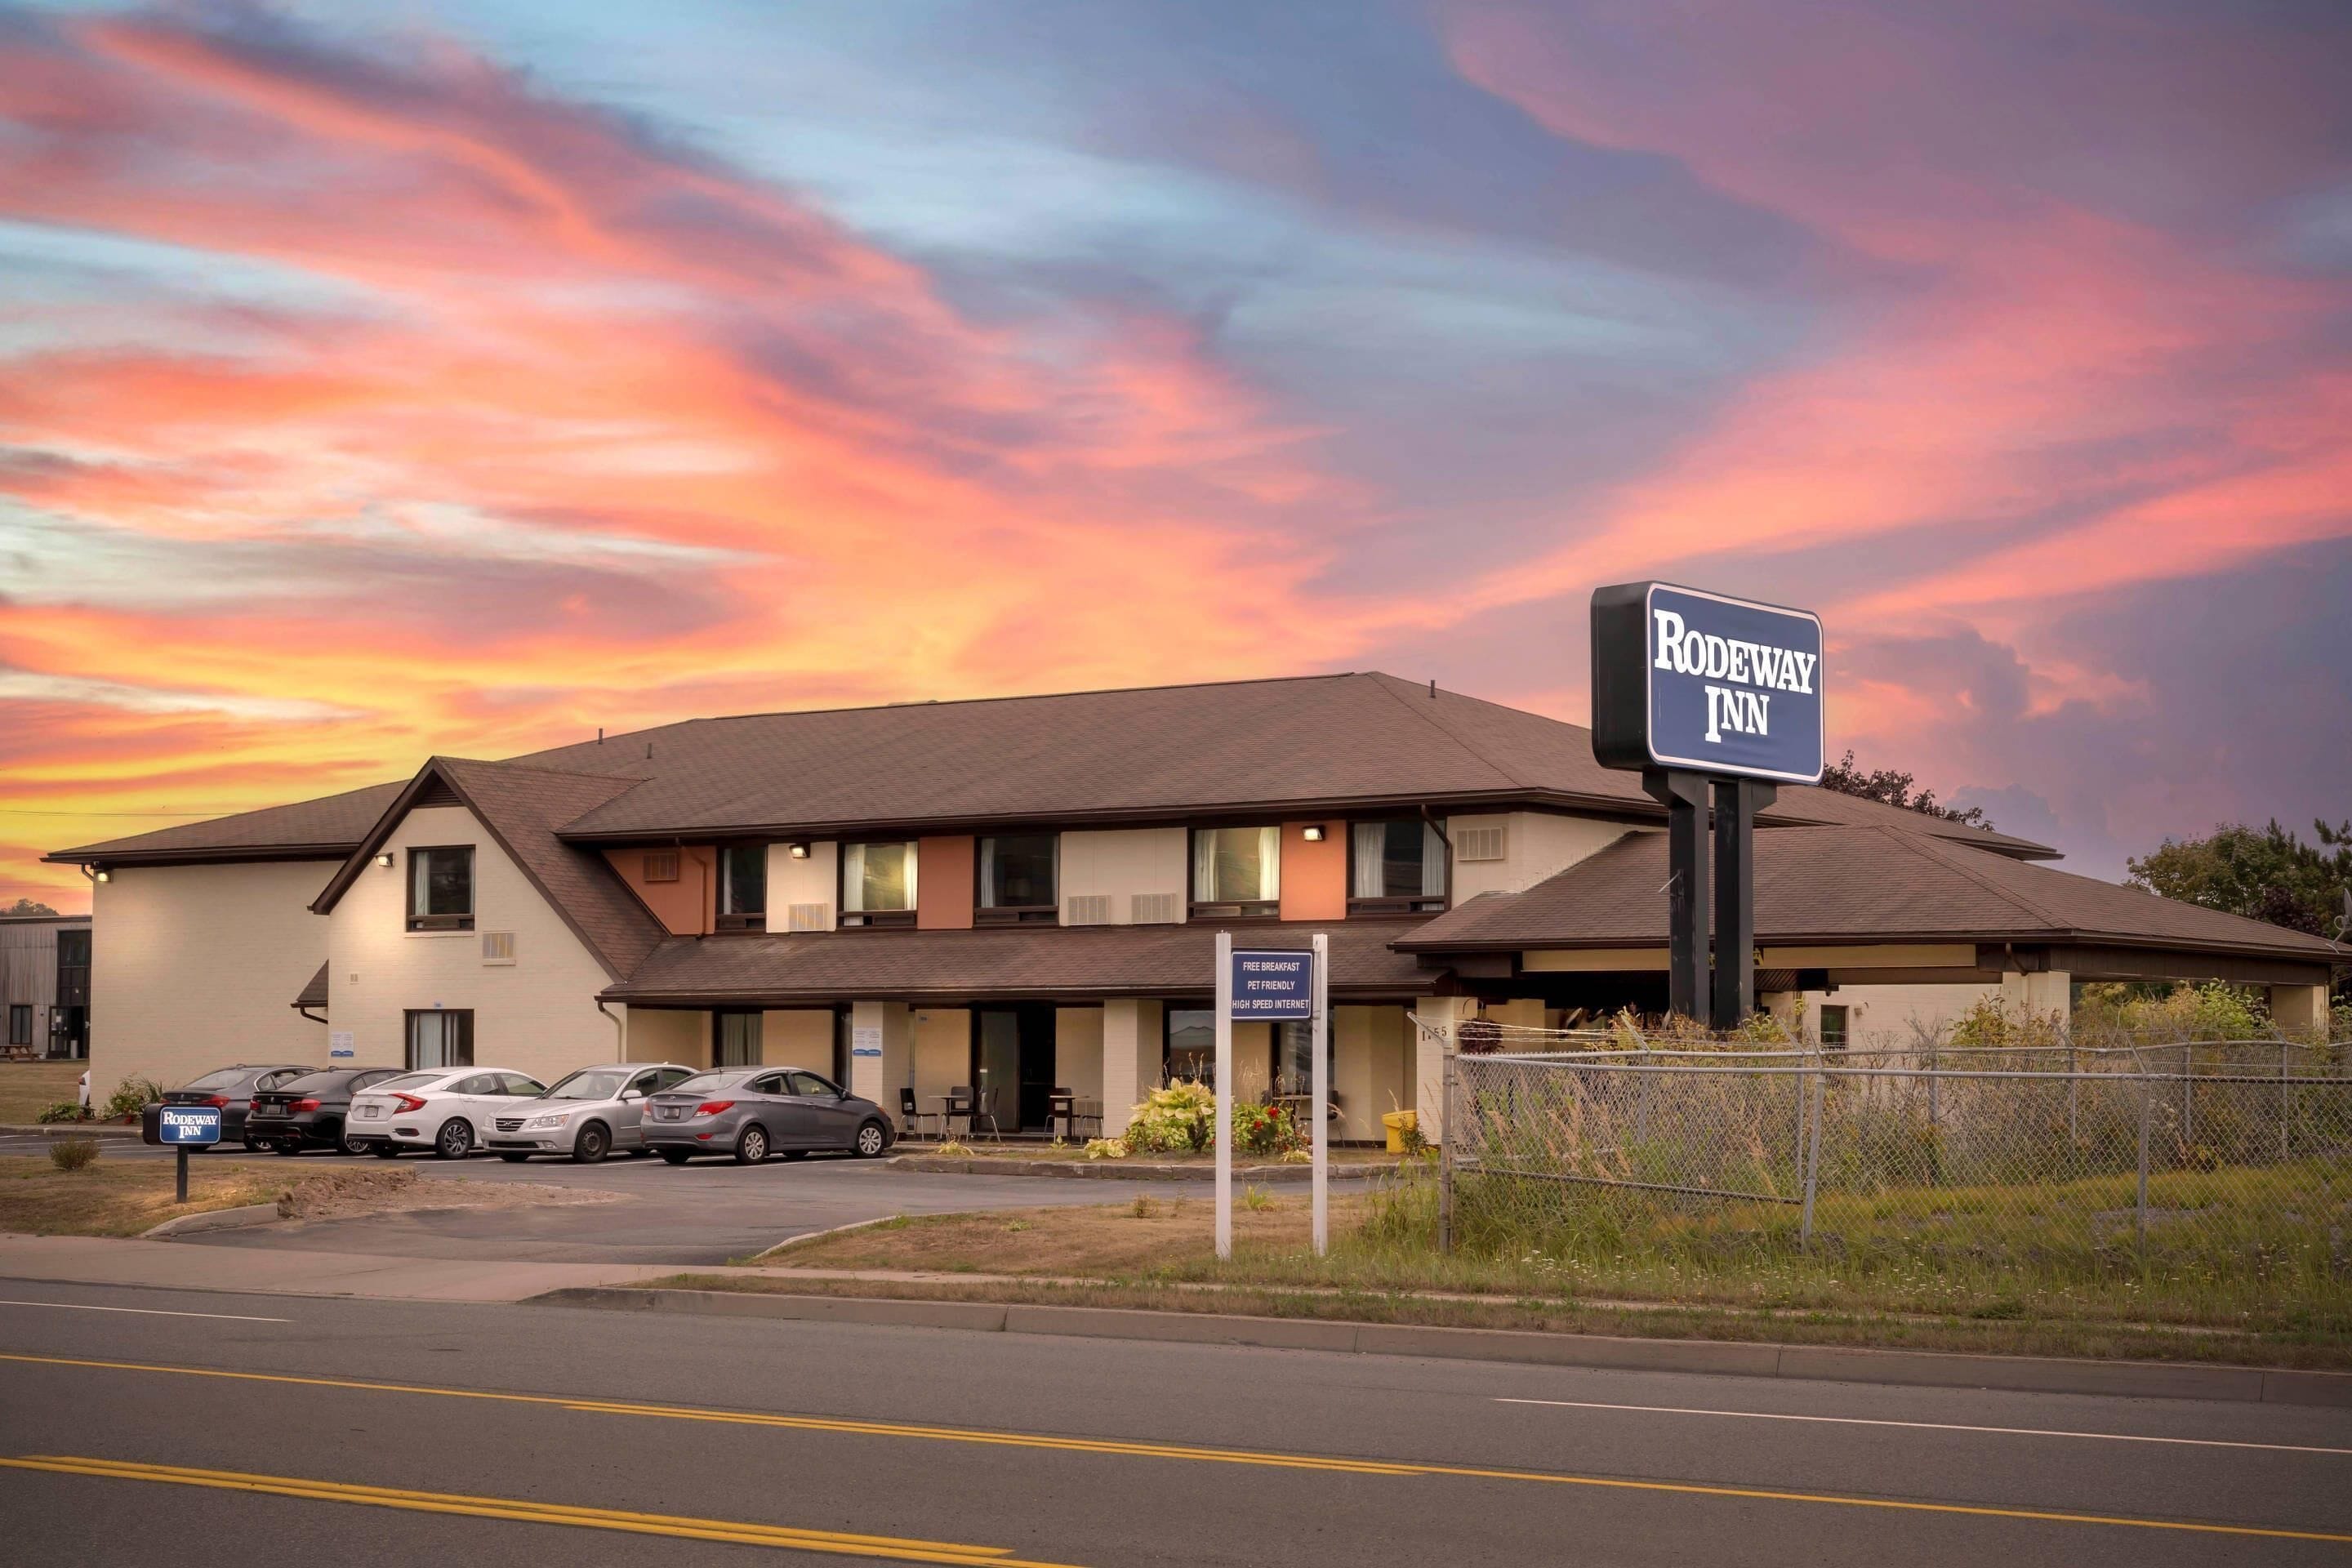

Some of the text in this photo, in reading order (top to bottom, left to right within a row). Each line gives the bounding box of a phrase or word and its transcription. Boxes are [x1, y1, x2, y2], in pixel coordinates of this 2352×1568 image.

[1654, 608, 1816, 694] RODEWAY
[1705, 685, 1770, 743] INN
[1243, 962, 1300, 972] FREE BREAKFAST
[1248, 981, 1295, 990] PET FRIENDLY
[1232, 1000, 1309, 1009] HIGH SPEED INTERNET
[163, 1111, 217, 1125] RODEWAY
[179, 1126, 202, 1139] INN
